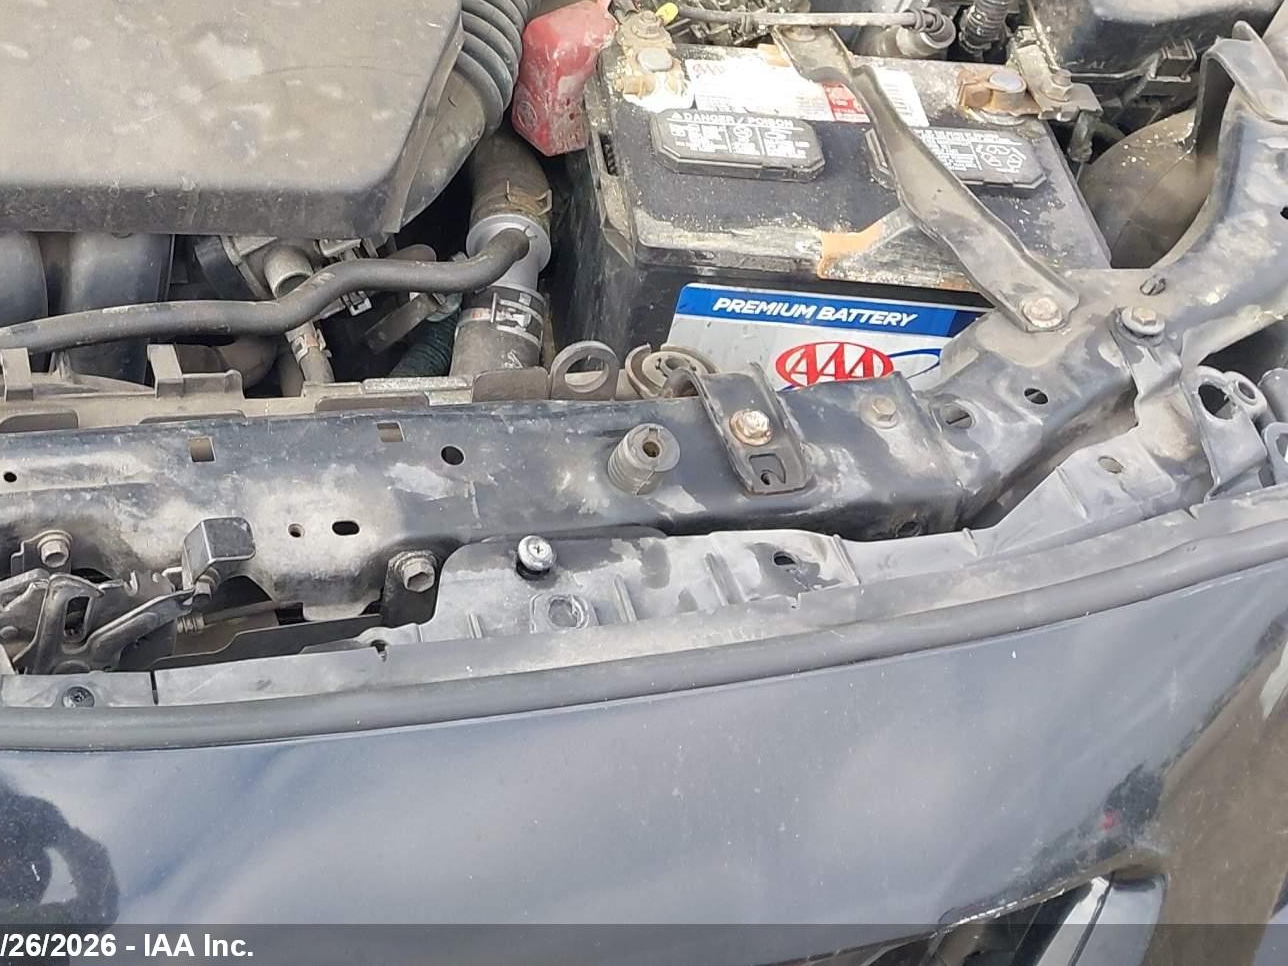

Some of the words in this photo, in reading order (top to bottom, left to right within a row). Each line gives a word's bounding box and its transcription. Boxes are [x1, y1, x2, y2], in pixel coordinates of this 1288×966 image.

[683, 113, 734, 125] DANGER
[747, 116, 794, 129] POISON
[713, 297, 815, 320] PREMIUM
[816, 305, 918, 327] BATTERY
[781, 342, 889, 388] AAA
